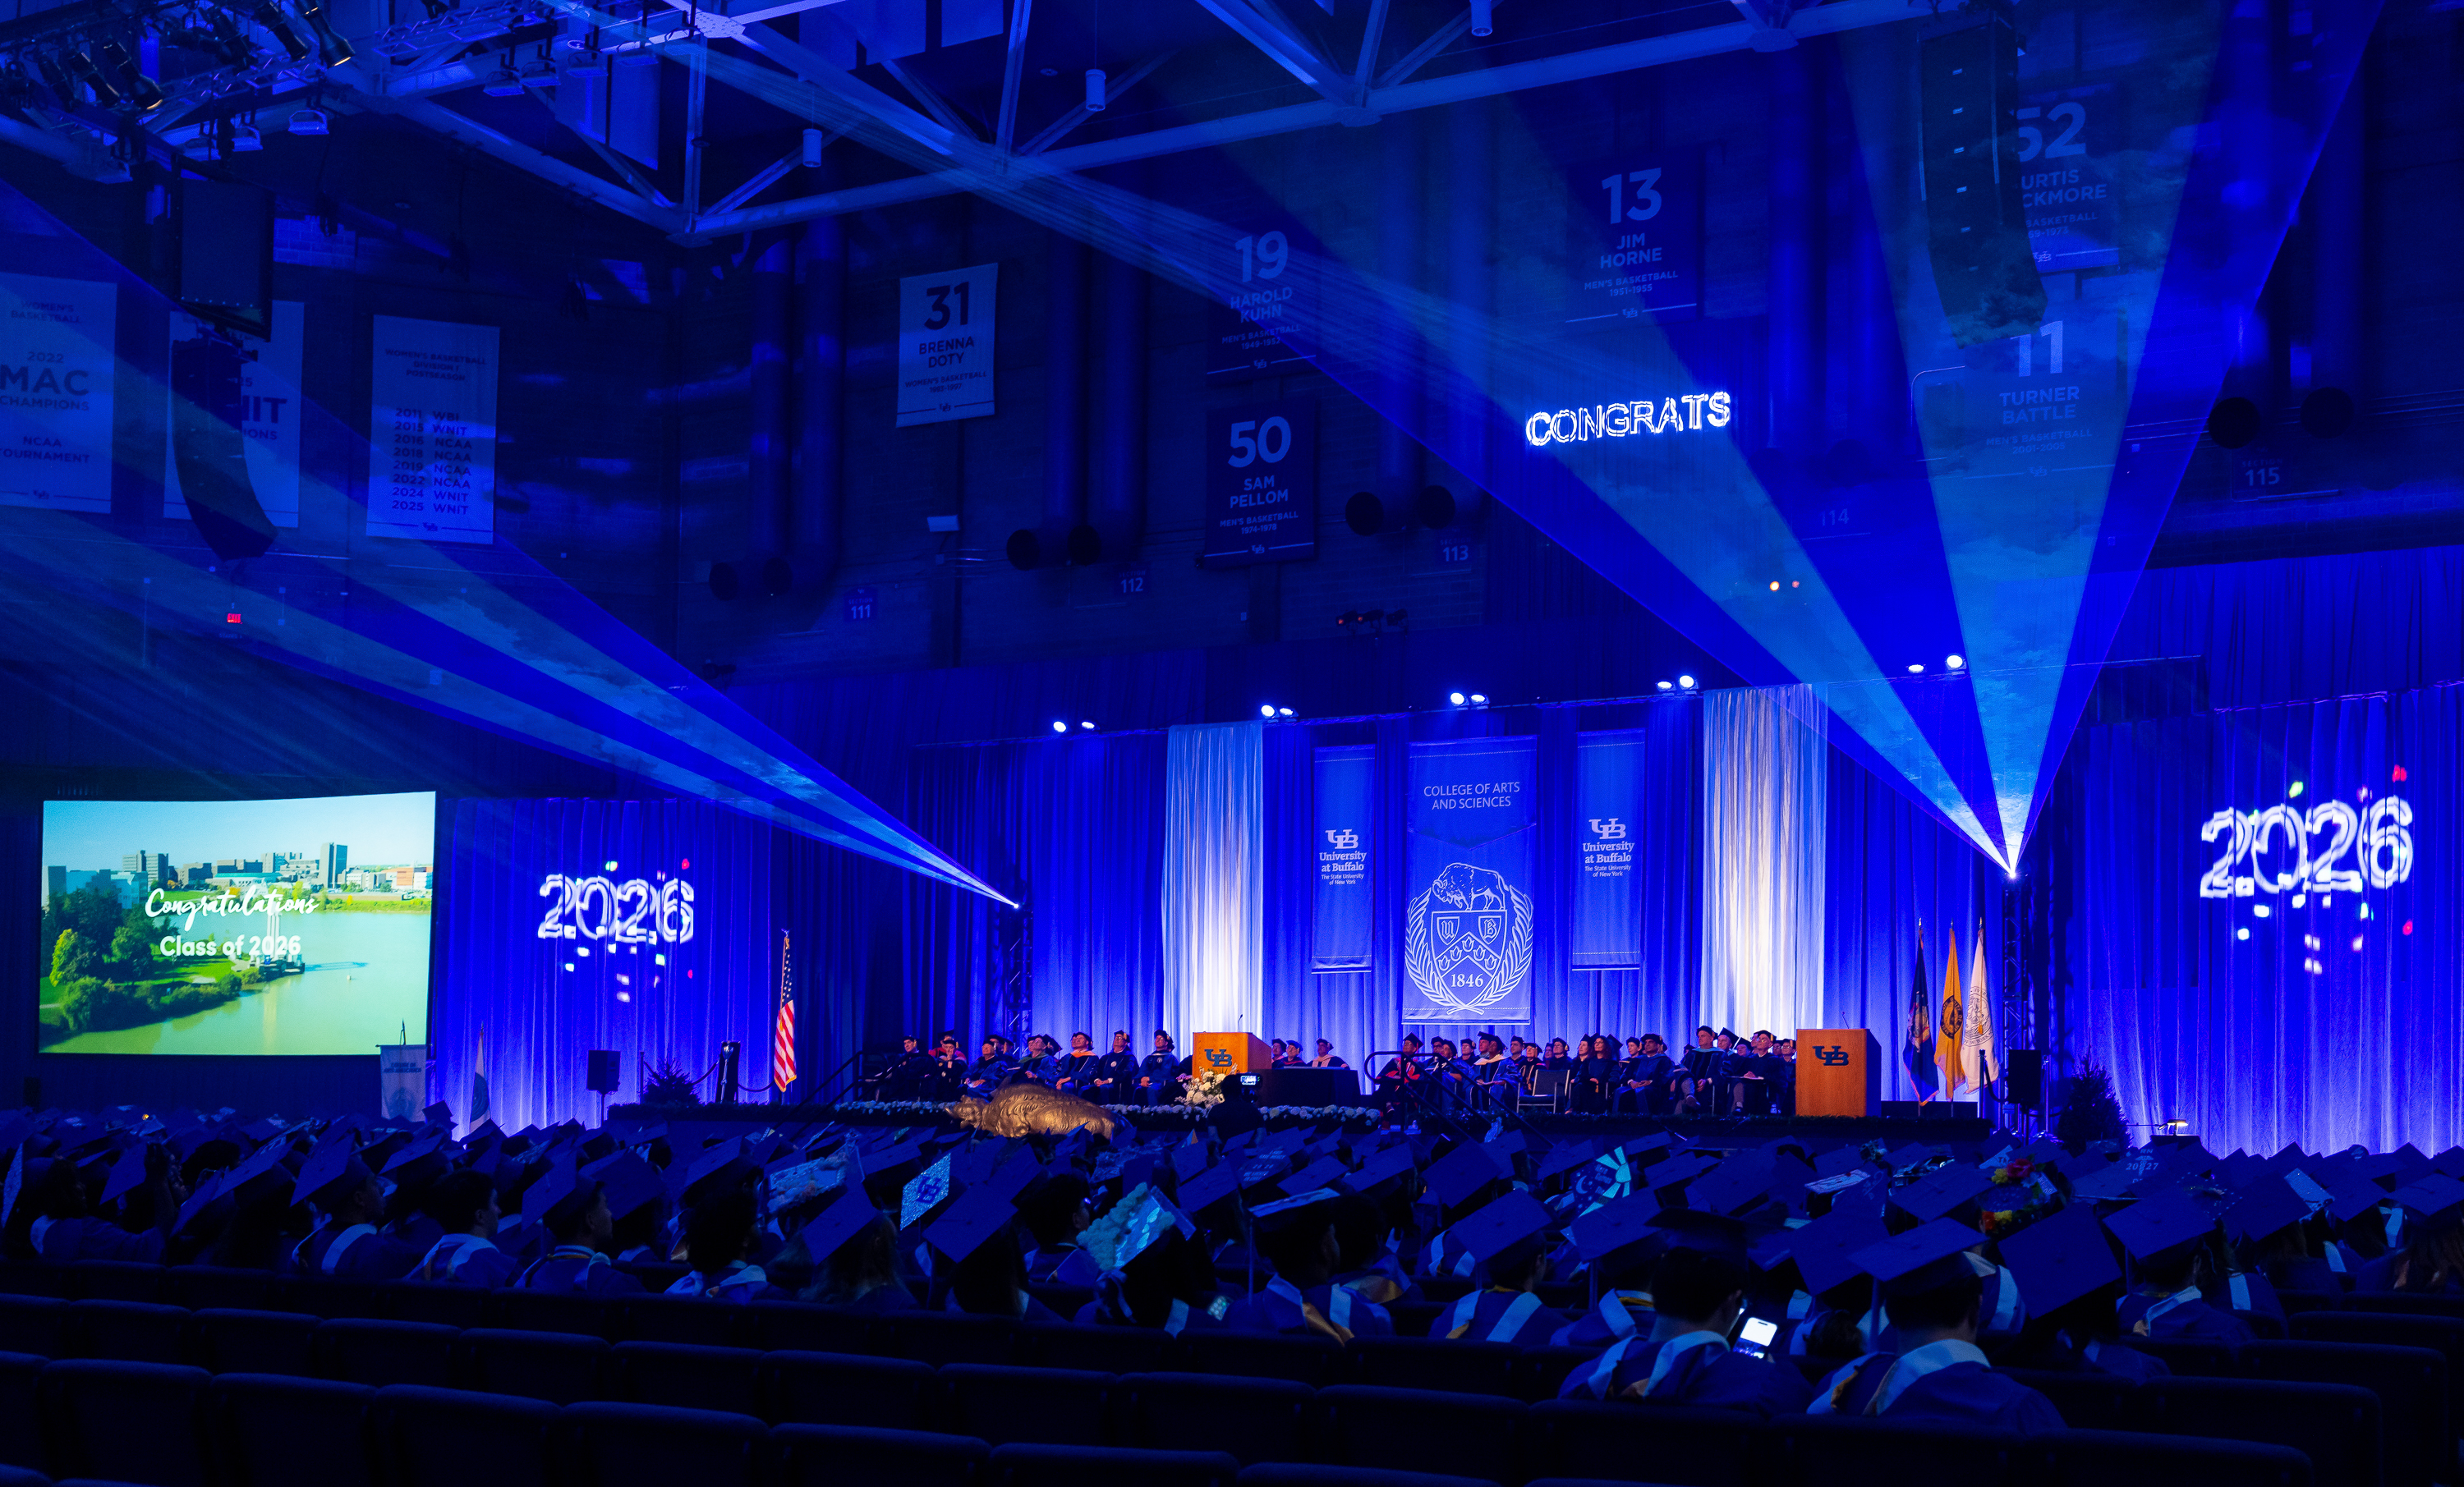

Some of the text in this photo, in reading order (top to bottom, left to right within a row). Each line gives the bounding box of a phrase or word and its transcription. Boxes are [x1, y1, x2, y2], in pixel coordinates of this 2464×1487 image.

[2016, 102, 2086, 163] 52
[2021, 169, 2080, 190] URTIS
[1602, 167, 1662, 225] 13
[2023, 183, 2108, 208] CKMORE
[2025, 211, 2099, 228] BASKETBALL
[1616, 232, 1646, 250] JIM
[2028, 226, 2069, 239] 69-1973
[1234, 230, 1289, 283] 19
[1600, 247, 1662, 268] HORNE
[1584, 270, 1679, 291] MEN'S BASKETBALL
[924, 281, 969, 330] 31
[1230, 286, 1294, 310] HAROLD
[11, 310, 83, 324] BASKETBALL
[1240, 304, 1282, 324] KUHN
[1221, 324, 1302, 344] MEN'S BASKETBALL
[919, 335, 975, 355] BRENNA
[2010, 320, 2064, 377] 11
[27, 351, 63, 364] 2022
[430, 353, 487, 365] BASKETBALL
[928, 351, 965, 368] DOTY
[0, 365, 89, 396] MAC
[940, 370, 987, 383] BASKETBALL
[0, 395, 89, 411] CHAMPIONS
[1999, 385, 2080, 406] TURNER
[396, 408, 460, 421] 2011 WBI
[1526, 391, 1731, 446] CONGRATS
[2002, 403, 2077, 425] BATTLE
[394, 421, 467, 435] 2015 WNIT
[23, 436, 62, 447] NCAA
[393, 434, 472, 449] 2016 NCAA
[1227, 415, 1292, 469] 50
[1986, 428, 2093, 446] MEN'S BASKETBALL
[0, 447, 90, 463] OURNAMENT
[393, 447, 471, 463] 2018 NCAA
[2012, 442, 2066, 455] 2001-2005
[393, 461, 471, 476] 2019 NCAA
[2245, 466, 2280, 487] 115
[393, 474, 471, 489] 2022 NCAA
[1243, 475, 1276, 492] SAM
[392, 487, 469, 502] 2024 WNIT
[1230, 489, 1289, 509] PELLOM
[391, 500, 469, 515] 2025 WNIT
[1246, 511, 1299, 525] BASKETBALL
[1818, 508, 1850, 526] 114
[1443, 545, 1469, 562] 113
[1120, 576, 1143, 593] 112
[851, 604, 871, 619] 111
[1424, 782, 1520, 797] COLLEGE OF ARTS
[1432, 796, 1511, 810] AND SCIENCES
[1583, 842, 1634, 852] University
[2200, 794, 2413, 898] 2026
[1319, 851, 1367, 862] University
[1585, 854, 1631, 864] at Buffalo
[1332, 862, 1364, 872] Buffalo
[145, 884, 319, 931] Congratulations
[538, 874, 694, 944] 2026
[160, 934, 301, 957] Class of 2026
[1450, 973, 1484, 988] 1846
